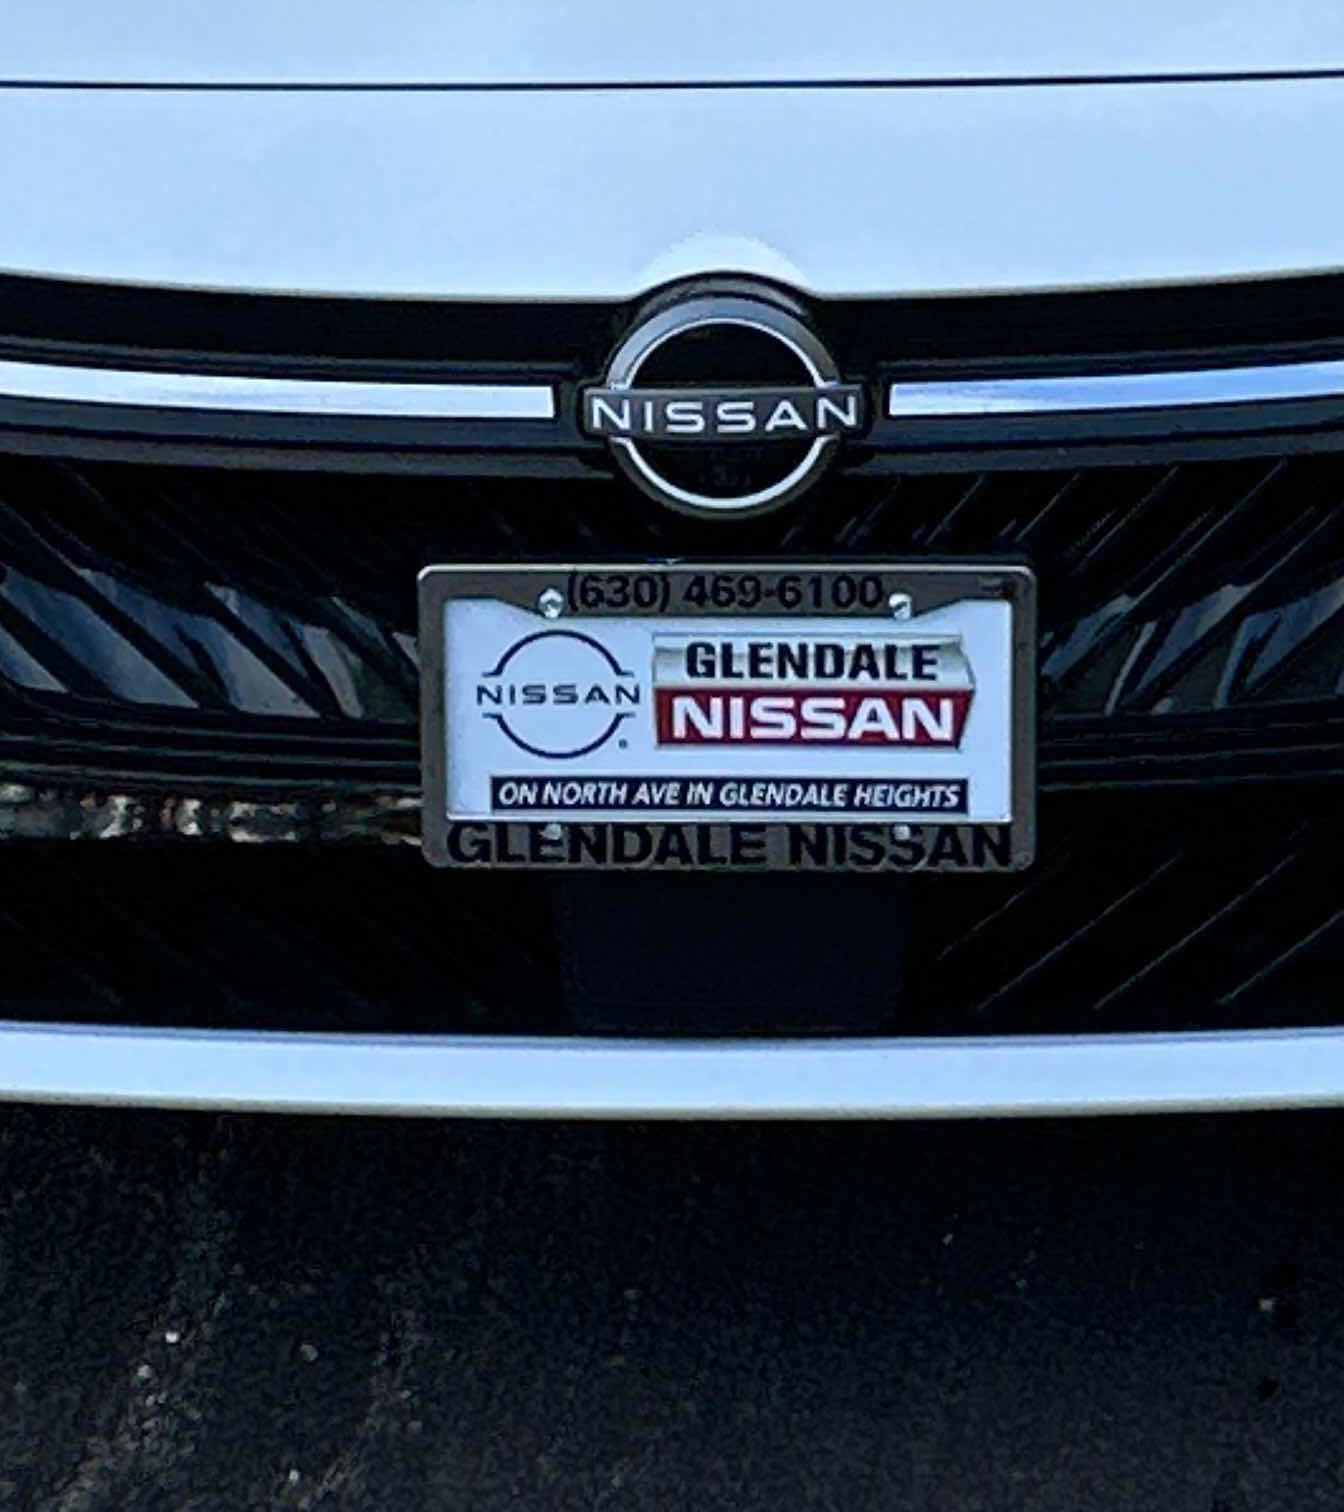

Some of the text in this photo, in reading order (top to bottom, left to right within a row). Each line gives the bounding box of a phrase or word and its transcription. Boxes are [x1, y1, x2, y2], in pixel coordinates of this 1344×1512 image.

[591, 395, 857, 434] NISSAN
[567, 571, 884, 612] (630) 469-6100
[685, 641, 941, 681] GLENDALE
[476, 683, 640, 706] NISSAN
[672, 696, 954, 740] NISSAN
[498, 782, 961, 808] ON NORTH AVE IN GLENDALE HEIGHTS
[446, 821, 1011, 867] GLENDALE NISSAN
